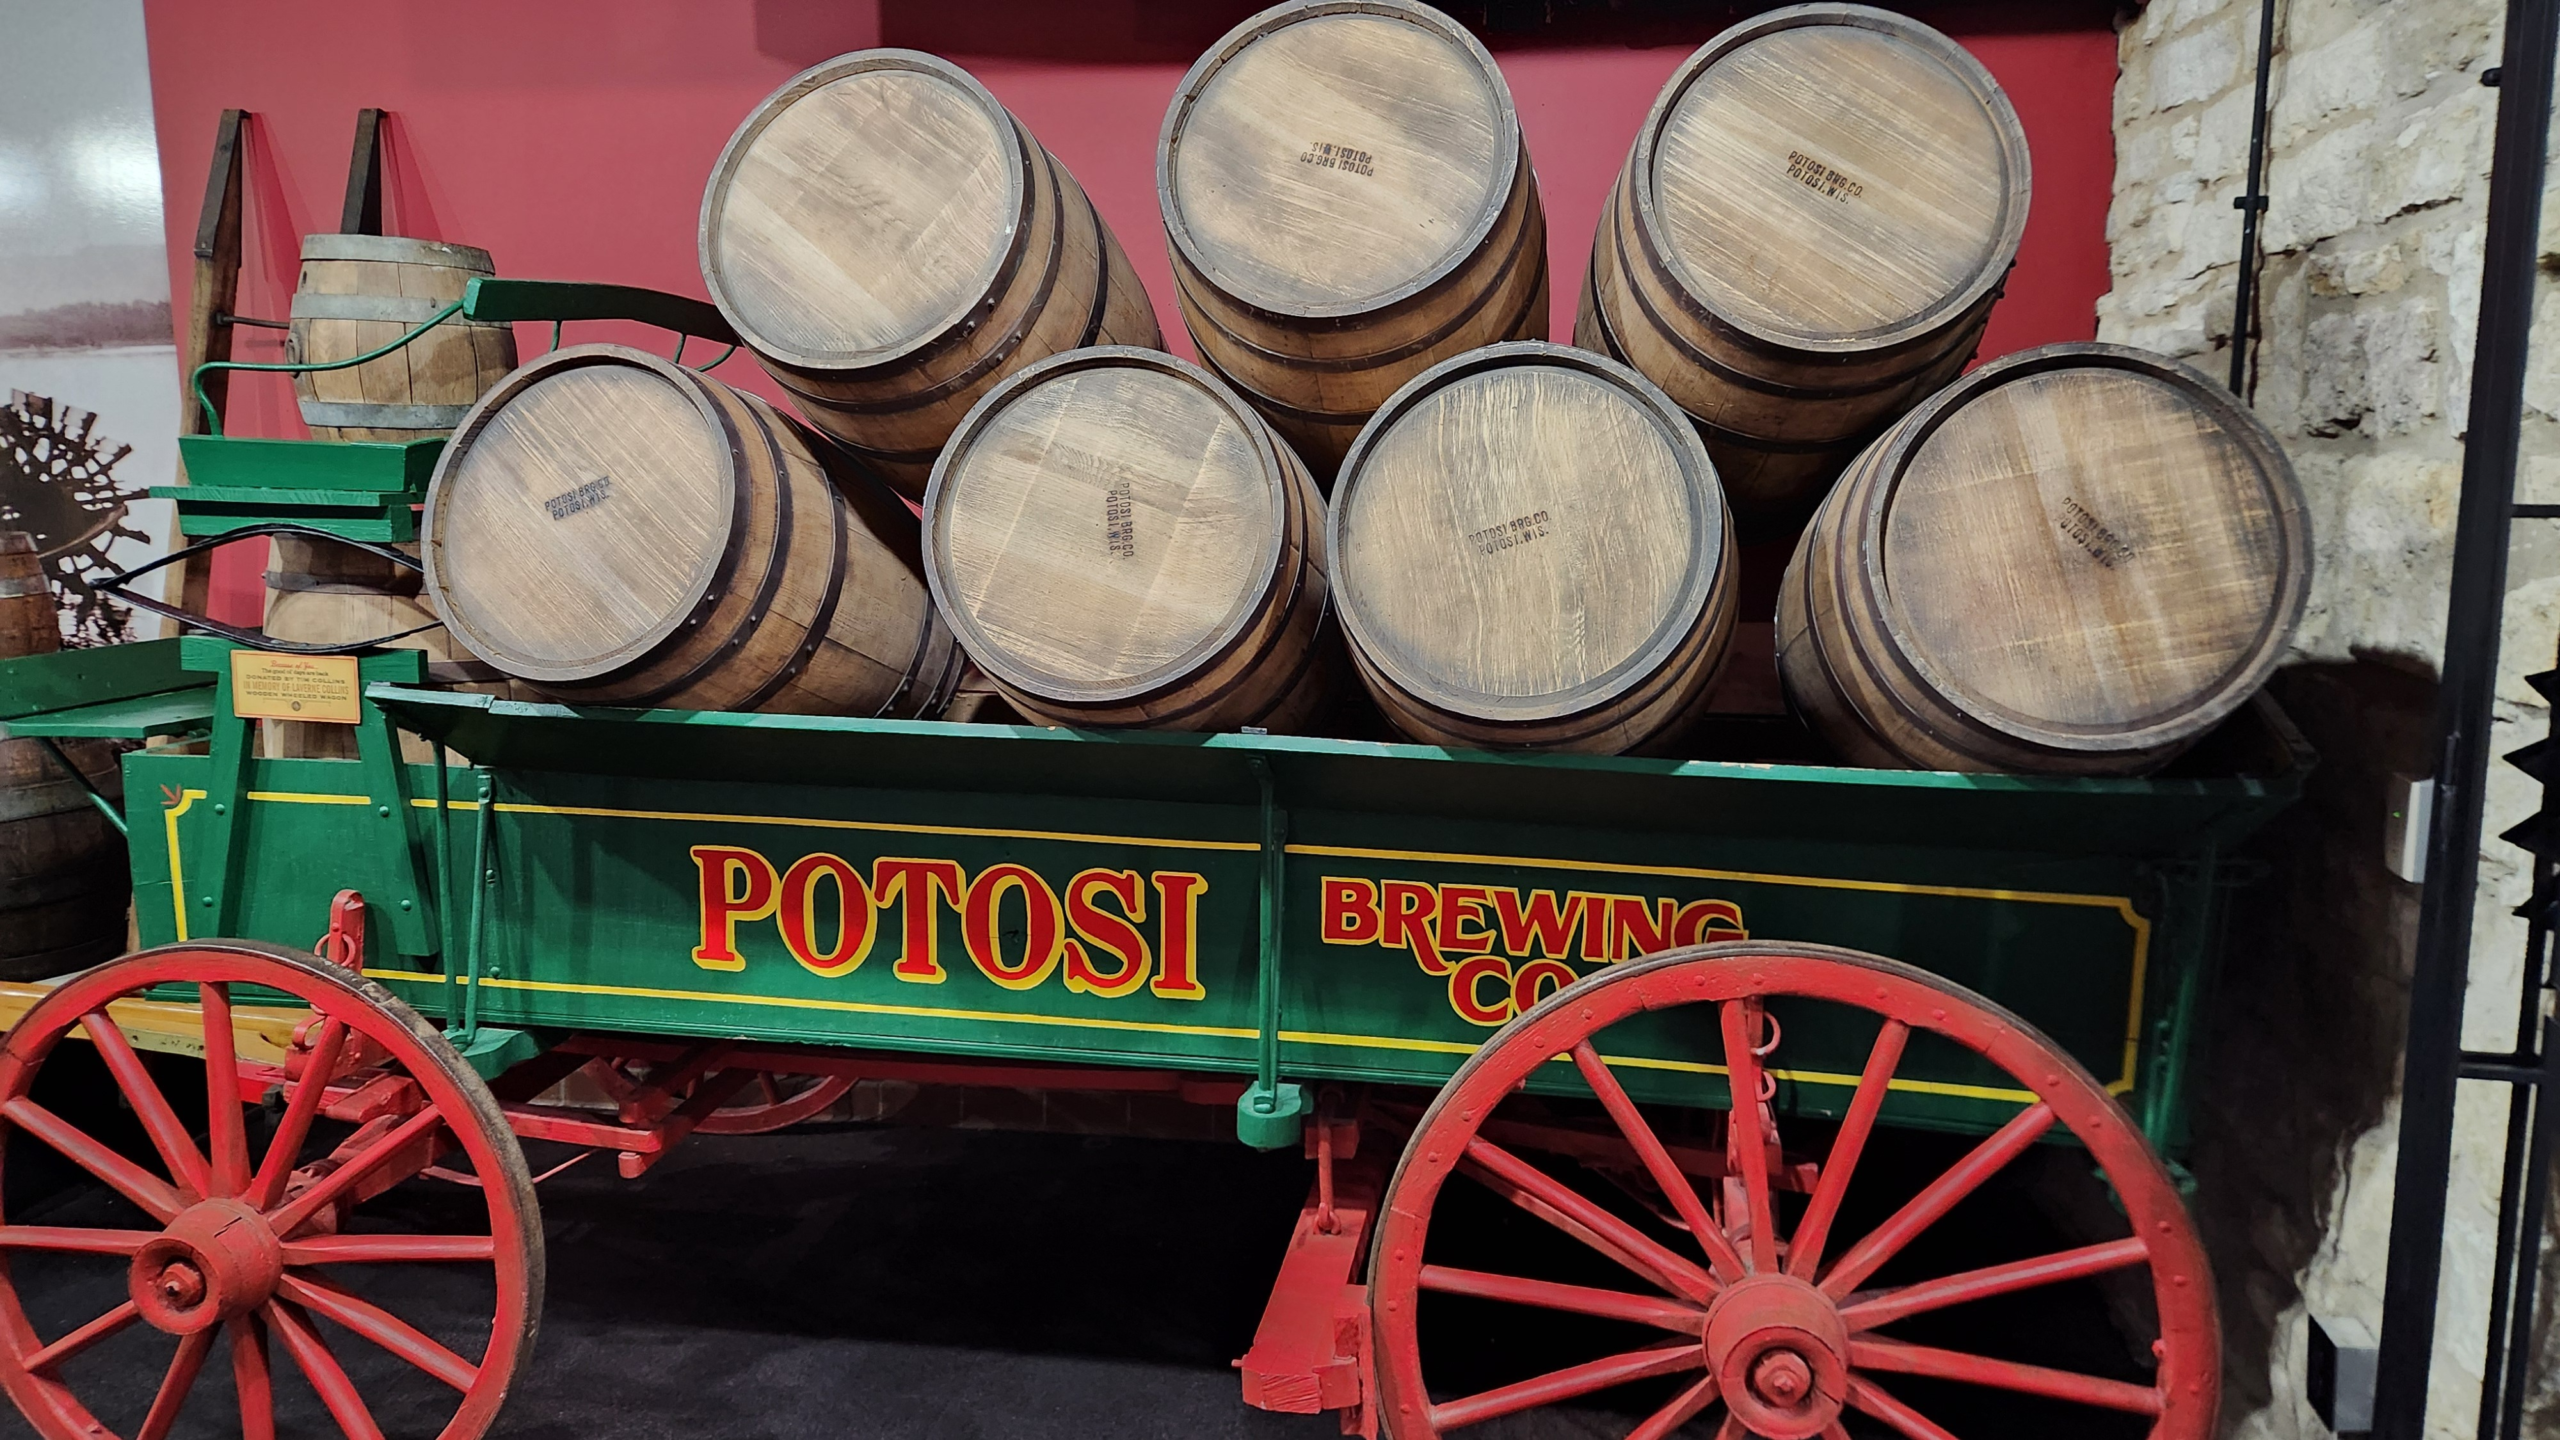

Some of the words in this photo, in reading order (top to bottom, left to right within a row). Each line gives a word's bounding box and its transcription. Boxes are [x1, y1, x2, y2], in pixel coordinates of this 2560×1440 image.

[1337, 159, 1374, 177] POTOSI
[1788, 150, 1827, 177] POTOSI
[544, 488, 577, 512] POTOSI
[1118, 482, 1132, 518] POTOSI
[1468, 523, 1508, 546] POTOSI
[243, 681, 251, 689] IN
[252, 681, 280, 691] MEMORY
[281, 683, 291, 692] OF
[292, 683, 321, 694] LAVERNE
[321, 685, 349, 695] COLLINS
[690, 845, 1208, 1000] POTOSI
[1320, 876, 1749, 976] BREWING
